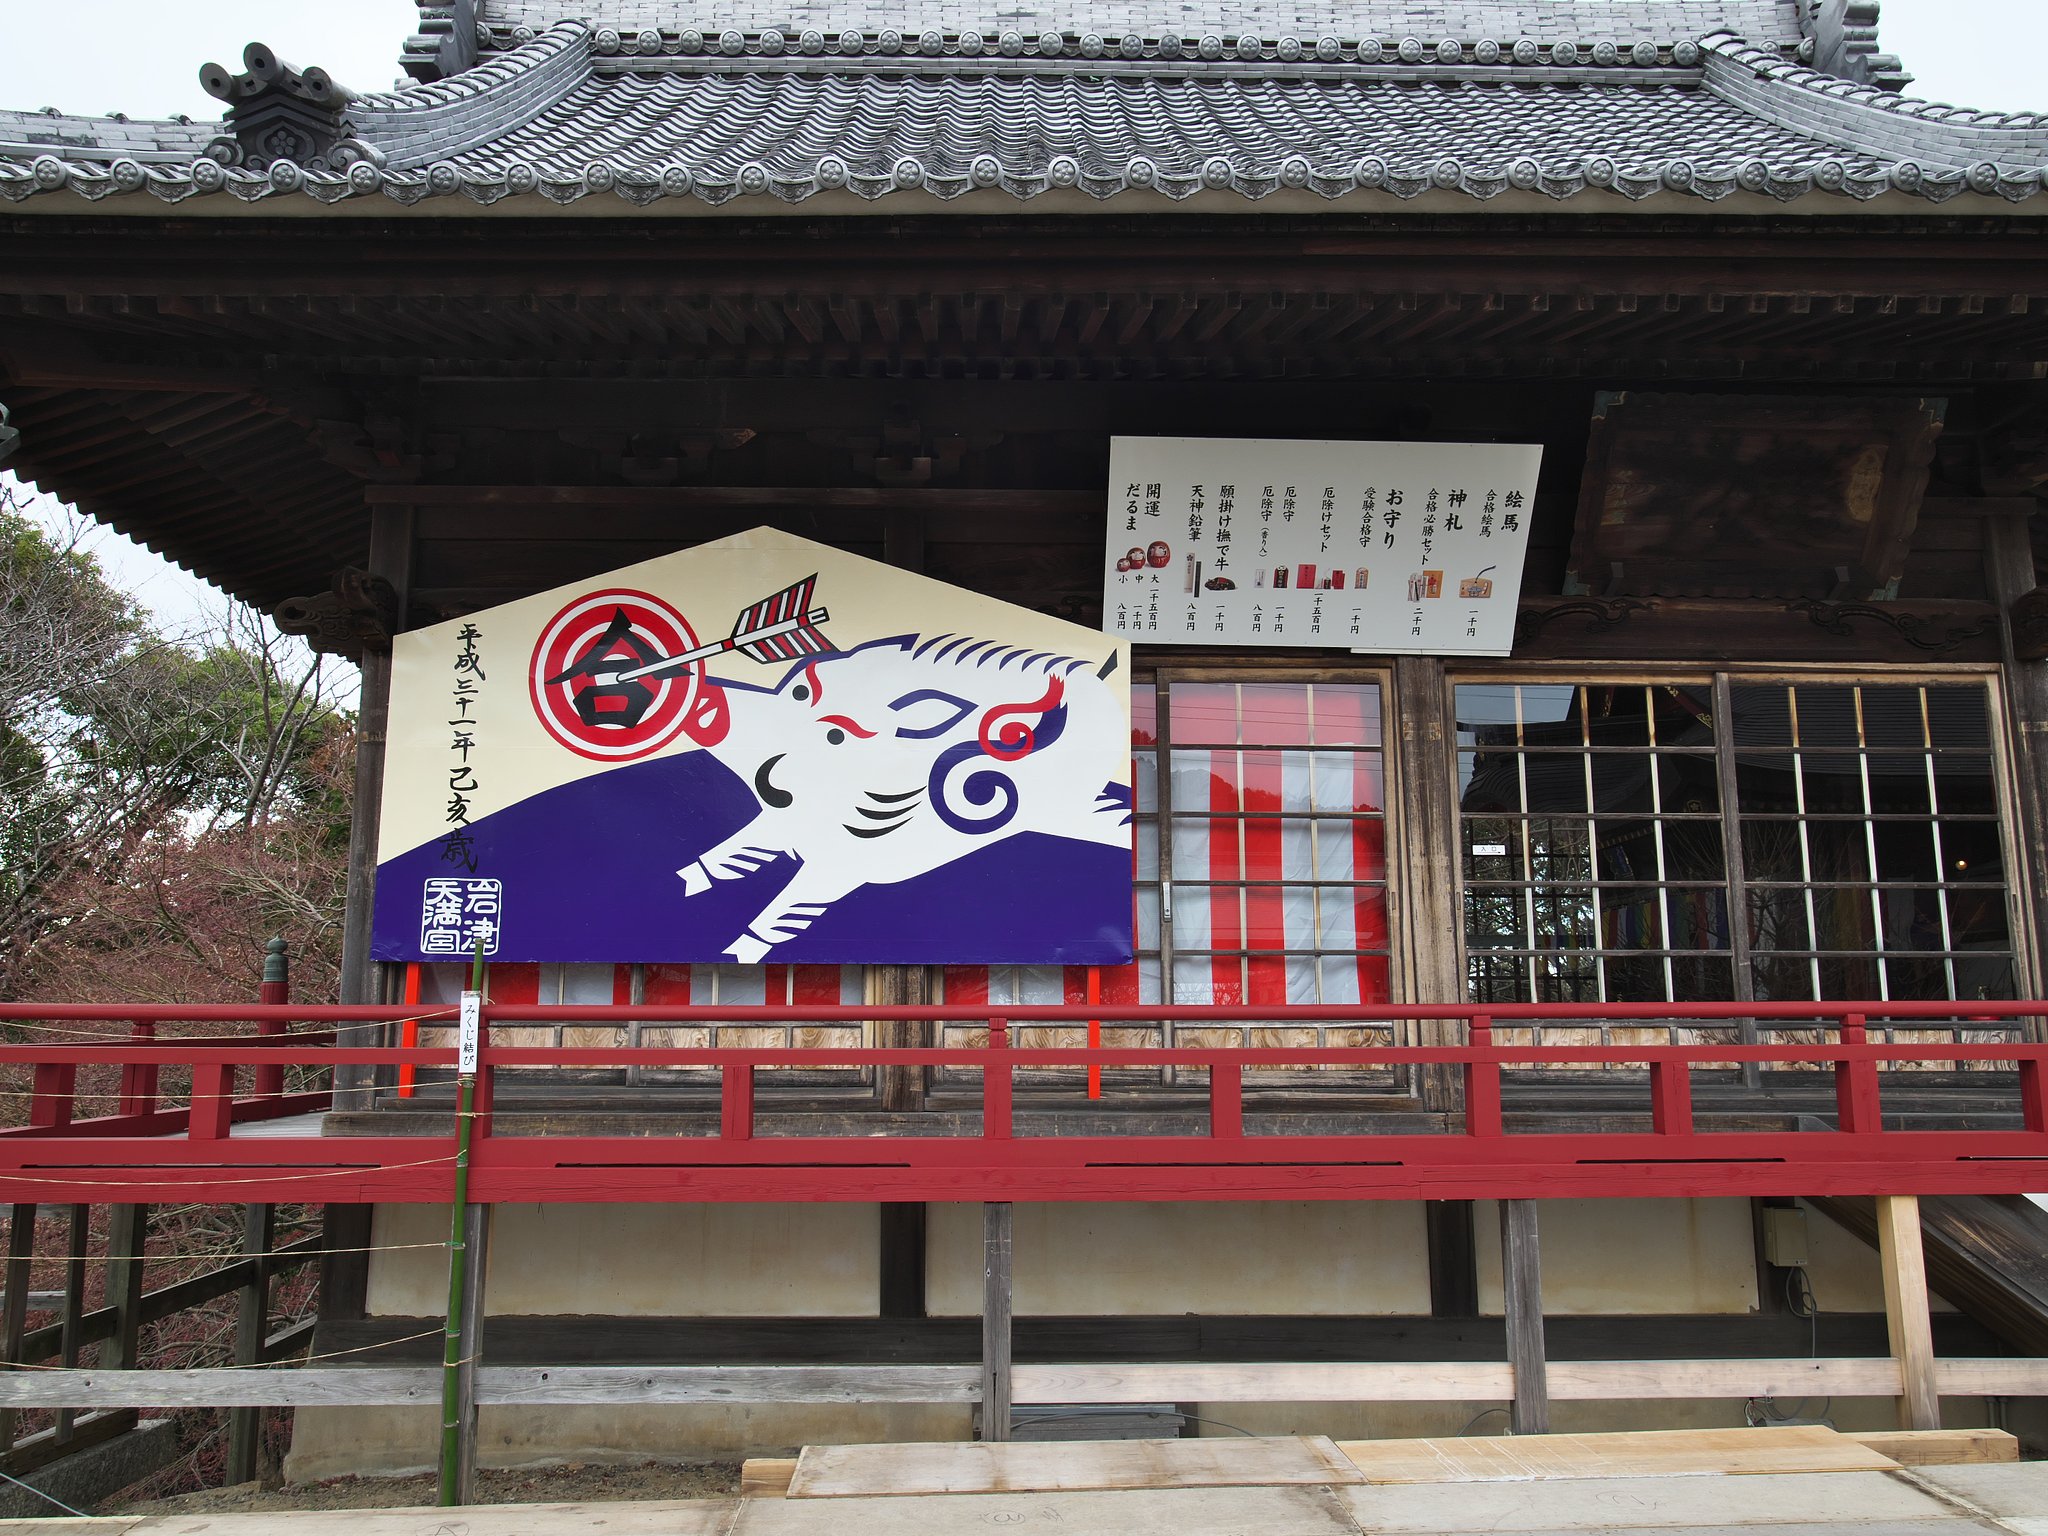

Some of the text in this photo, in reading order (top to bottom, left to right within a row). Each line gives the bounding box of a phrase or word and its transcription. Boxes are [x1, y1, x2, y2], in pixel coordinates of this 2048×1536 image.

[1126, 483, 1140, 530] だるま
[1144, 483, 1161, 517] 開運
[1189, 485, 1204, 541] 天神鉛筆
[1283, 486, 1296, 522] 厄除守
[1320, 487, 1335, 552] 厄除けセット
[1359, 487, 1376, 548] 受験合格守
[1383, 489, 1403, 549] お守り
[1444, 489, 1467, 531] 神札
[1479, 489, 1497, 537] 合格絵馬
[1501, 490, 1524, 532] 絵馬
[1215, 485, 1234, 571] 願掛け撫で牛
[1421, 488, 1439, 565] 合格必勝セット
[1117, 575, 1128, 629] 小 八百円
[1133, 575, 1144, 630] 中 一千円
[1187, 603, 1196, 631] 八百円
[1215, 606, 1225, 631] 一千円
[1252, 604, 1262, 632] 八百円
[1275, 607, 1285, 632] 一千円
[1312, 593, 1323, 633] 一千五百円
[1350, 608, 1361, 634] 一千円
[1412, 608, 1423, 635] 二千円
[1467, 610, 1479, 636] 一千円
[544, 606, 695, 729] 合
[424, 881, 463, 952] 天満宮
[461, 881, 498, 951] 岩津
[463, 1005, 476, 1065] みくじ結び
